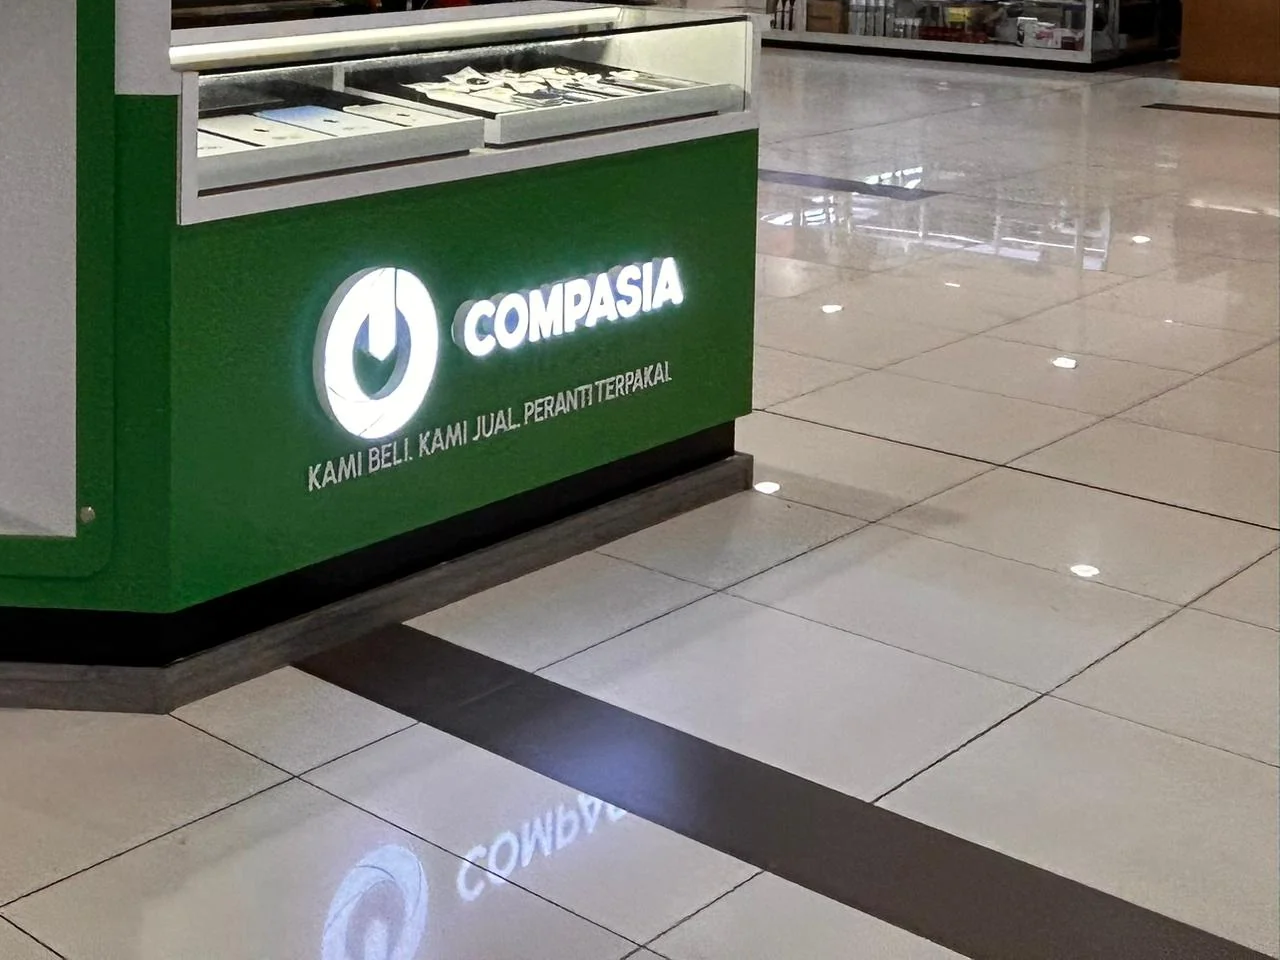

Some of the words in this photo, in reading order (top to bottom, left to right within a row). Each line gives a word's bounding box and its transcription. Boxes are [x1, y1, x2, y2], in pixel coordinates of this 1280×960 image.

[458, 256, 685, 357] COMPASIA
[308, 450, 363, 493] KAMI
[368, 437, 414, 474] BELI.
[418, 419, 468, 458] KAMI
[523, 384, 593, 426] PERANTI
